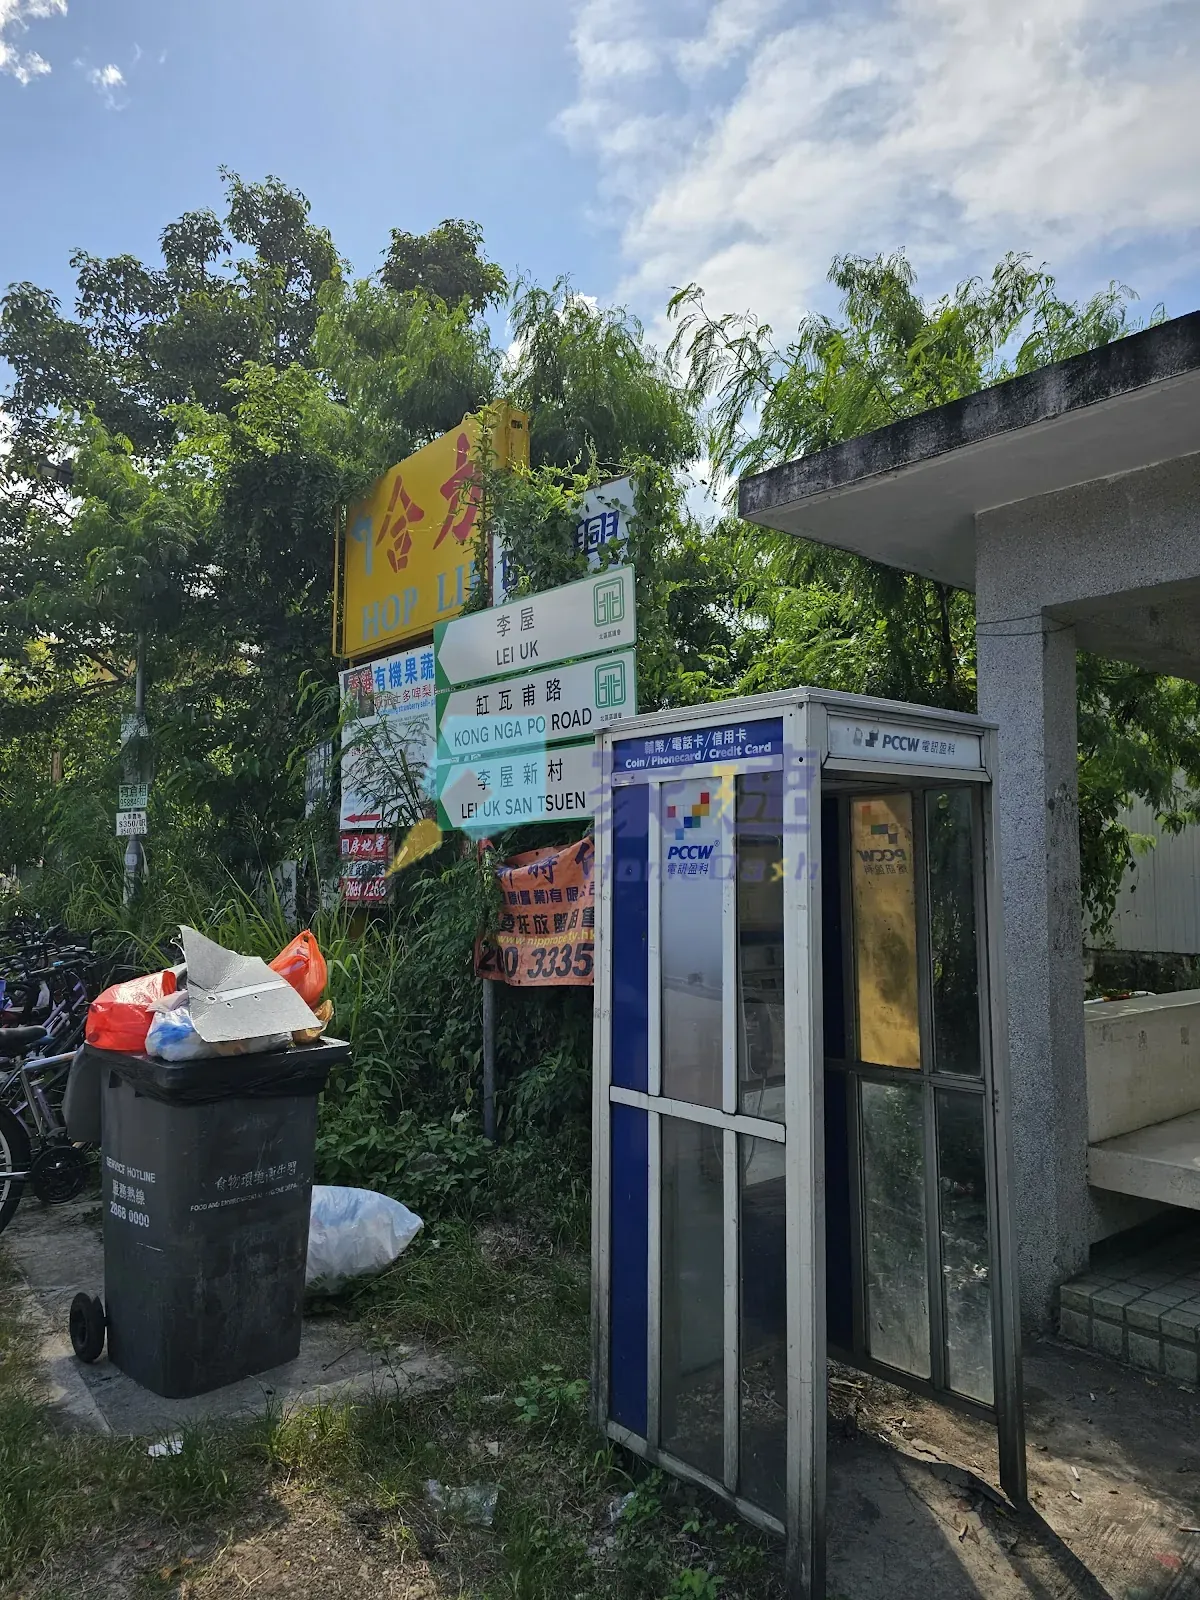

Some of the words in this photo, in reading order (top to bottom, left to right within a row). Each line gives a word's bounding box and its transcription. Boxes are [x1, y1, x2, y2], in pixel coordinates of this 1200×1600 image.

[362, 587, 418, 641] HOP
[496, 606, 535, 637] 李屋
[496, 646, 514, 666] LEI
[520, 639, 539, 660] UK
[476, 677, 562, 716] 缸瓦甫路
[454, 726, 489, 748] KONG
[494, 720, 523, 741] NGA
[528, 715, 546, 735] PO
[551, 707, 592, 731] ROAD
[744, 741, 772, 754] Card
[882, 734, 920, 752] PCCW
[921, 740, 956, 756] 電訊盈科
[477, 758, 563, 791] 李屋新村
[461, 802, 478, 819] LEI
[483, 800, 501, 817] UK
[505, 796, 532, 815] SAN
[537, 790, 586, 812] TSUEN
[667, 845, 714, 860] PCCW
[667, 862, 709, 875] 電訊盈科
[527, 942, 595, 979] 3335
[126, 1166, 156, 1184] HOTLINE
[109, 1200, 127, 1220] 2868
[128, 1210, 150, 1228] 0000
[190, 1203, 208, 1212] FOOD
[207, 1200, 220, 1209] AND
